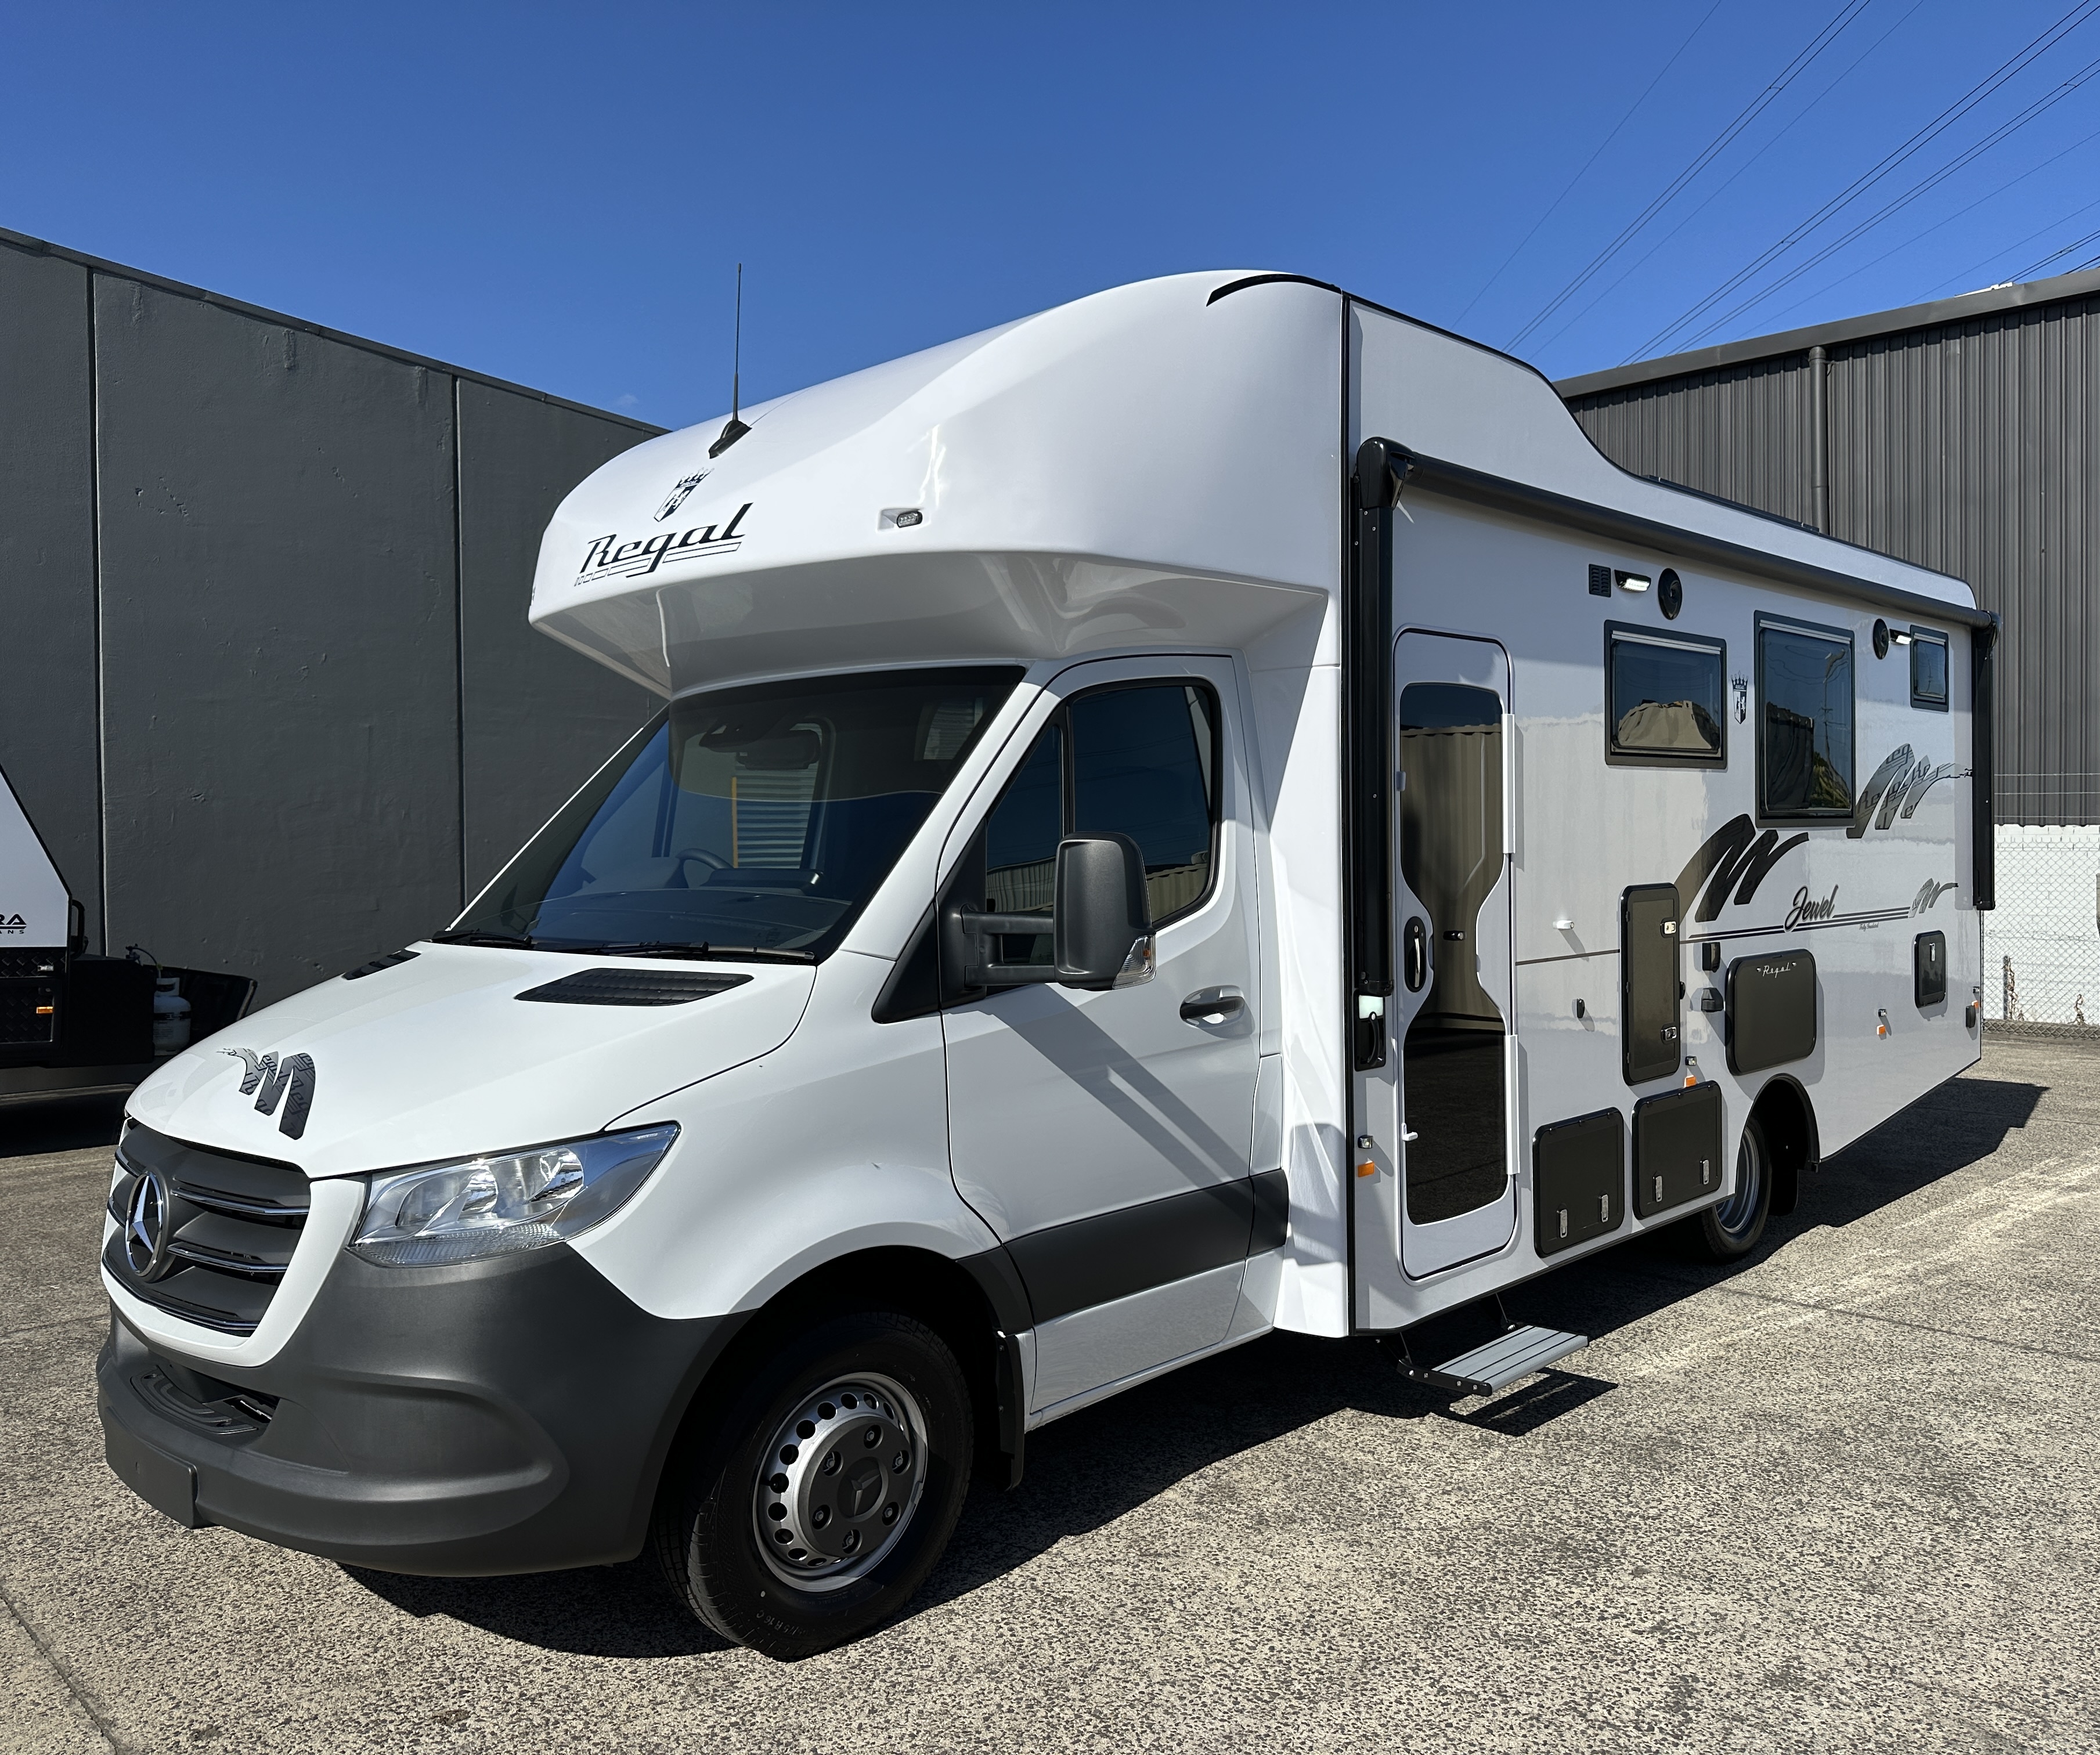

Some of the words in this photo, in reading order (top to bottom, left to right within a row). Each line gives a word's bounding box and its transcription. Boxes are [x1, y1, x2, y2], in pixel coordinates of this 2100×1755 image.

[580, 503, 753, 578] Regal
[1784, 884, 1839, 931] Jewel
[1762, 962, 1791, 978] Regal
